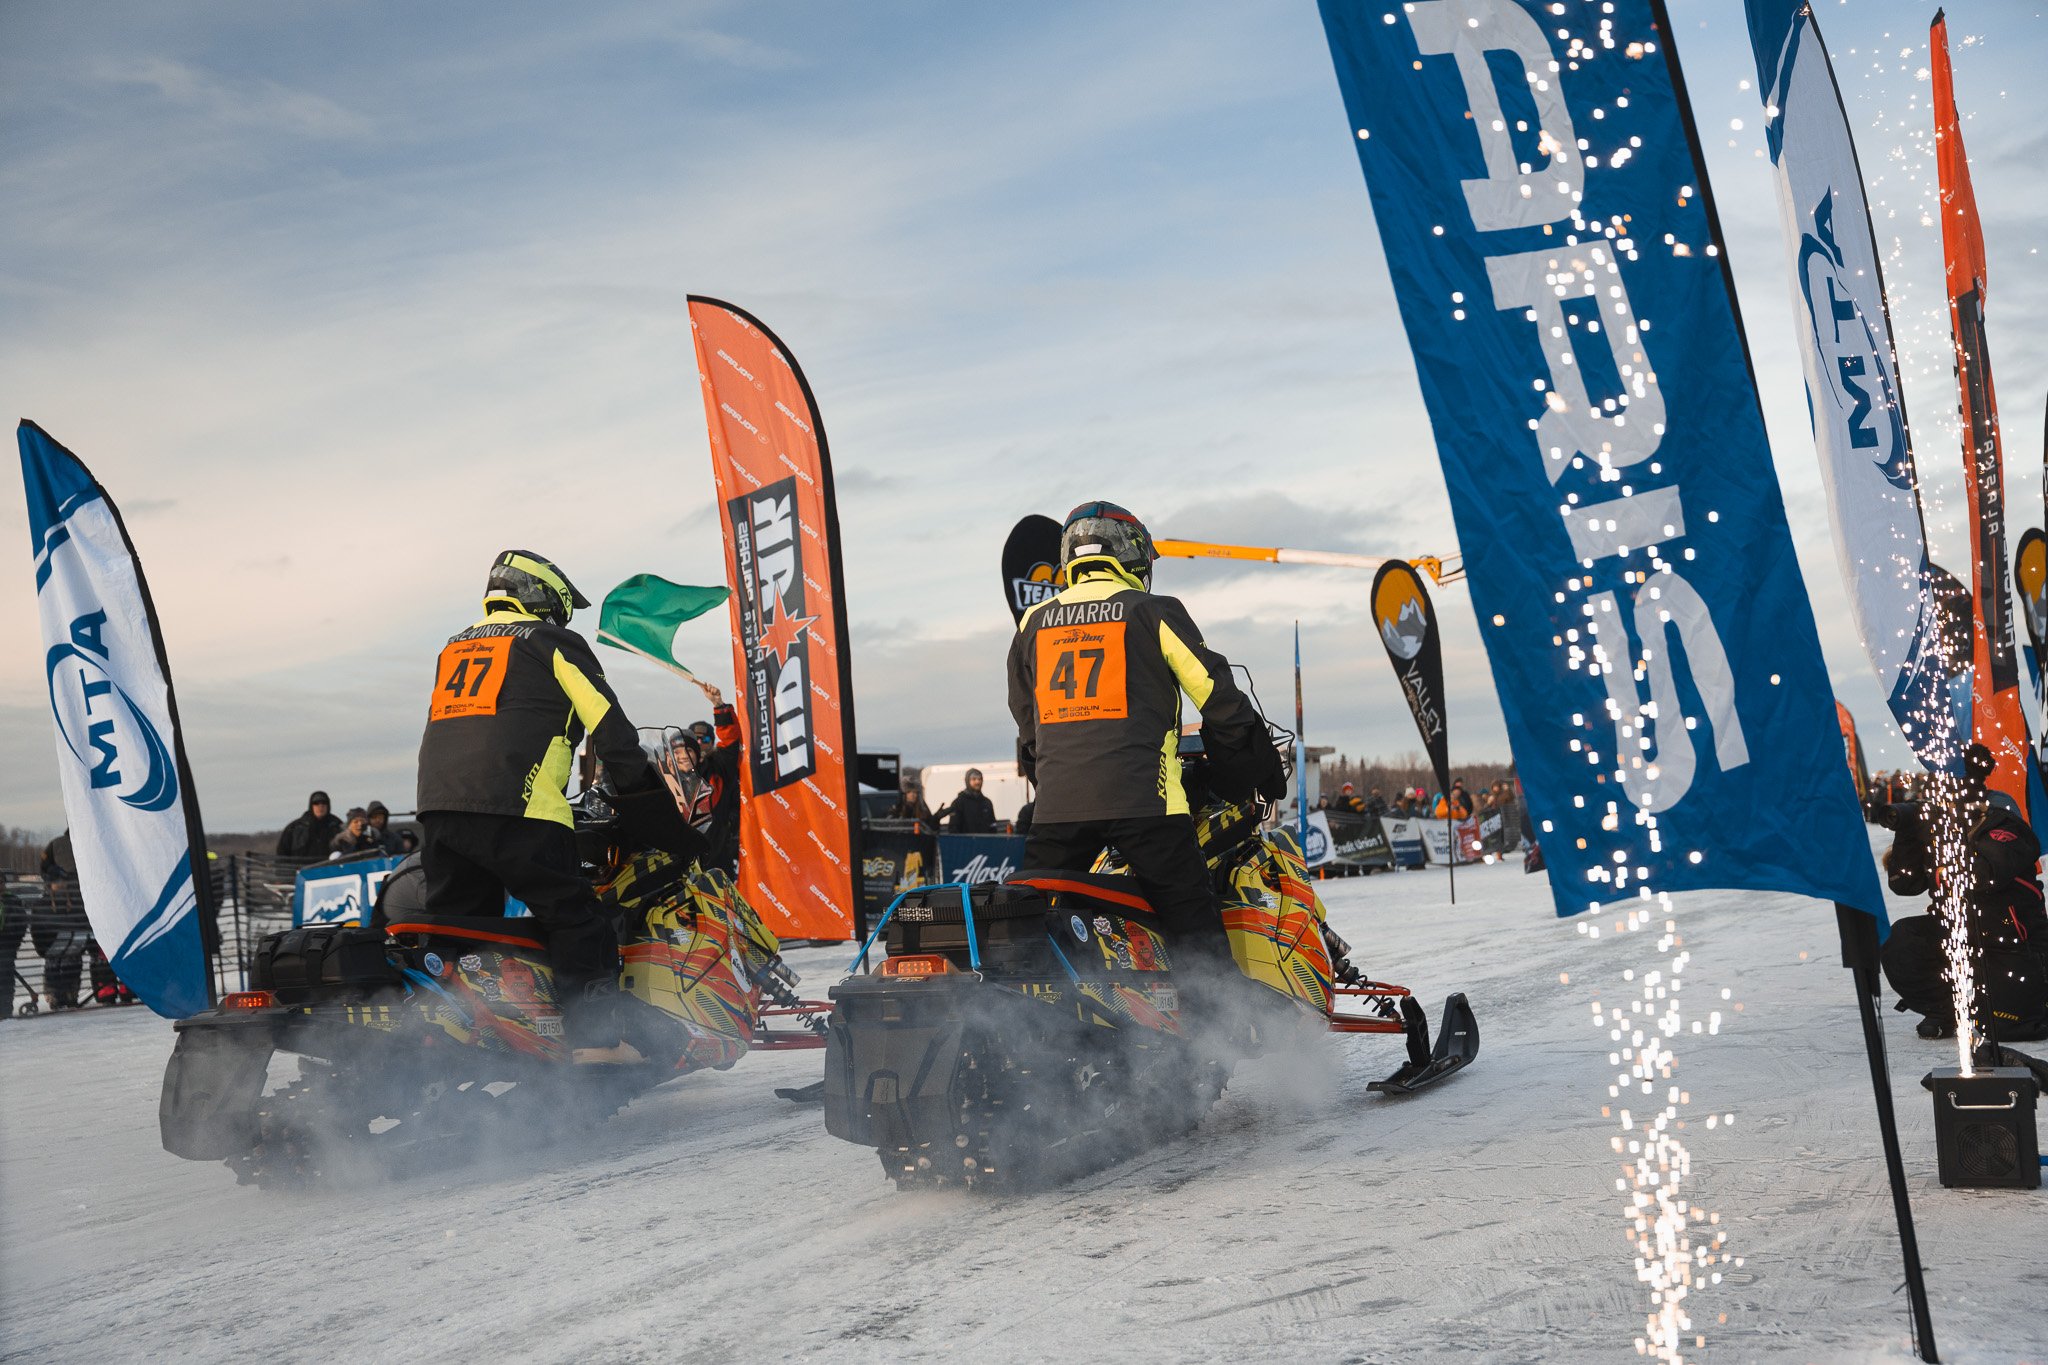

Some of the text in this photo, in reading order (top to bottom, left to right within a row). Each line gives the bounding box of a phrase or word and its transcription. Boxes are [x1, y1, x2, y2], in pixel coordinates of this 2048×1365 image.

[1814, 185, 1880, 450] MTA
[1041, 601, 1124, 628] NAVARRO
[444, 656, 494, 698] 47
[1049, 647, 1105, 700] 47
[69, 606, 122, 789] MTA
[1069, 704, 1100, 712] DONLIN
[1406, 659, 1443, 736] VALLEY
[537, 1022, 561, 1036] U8150
